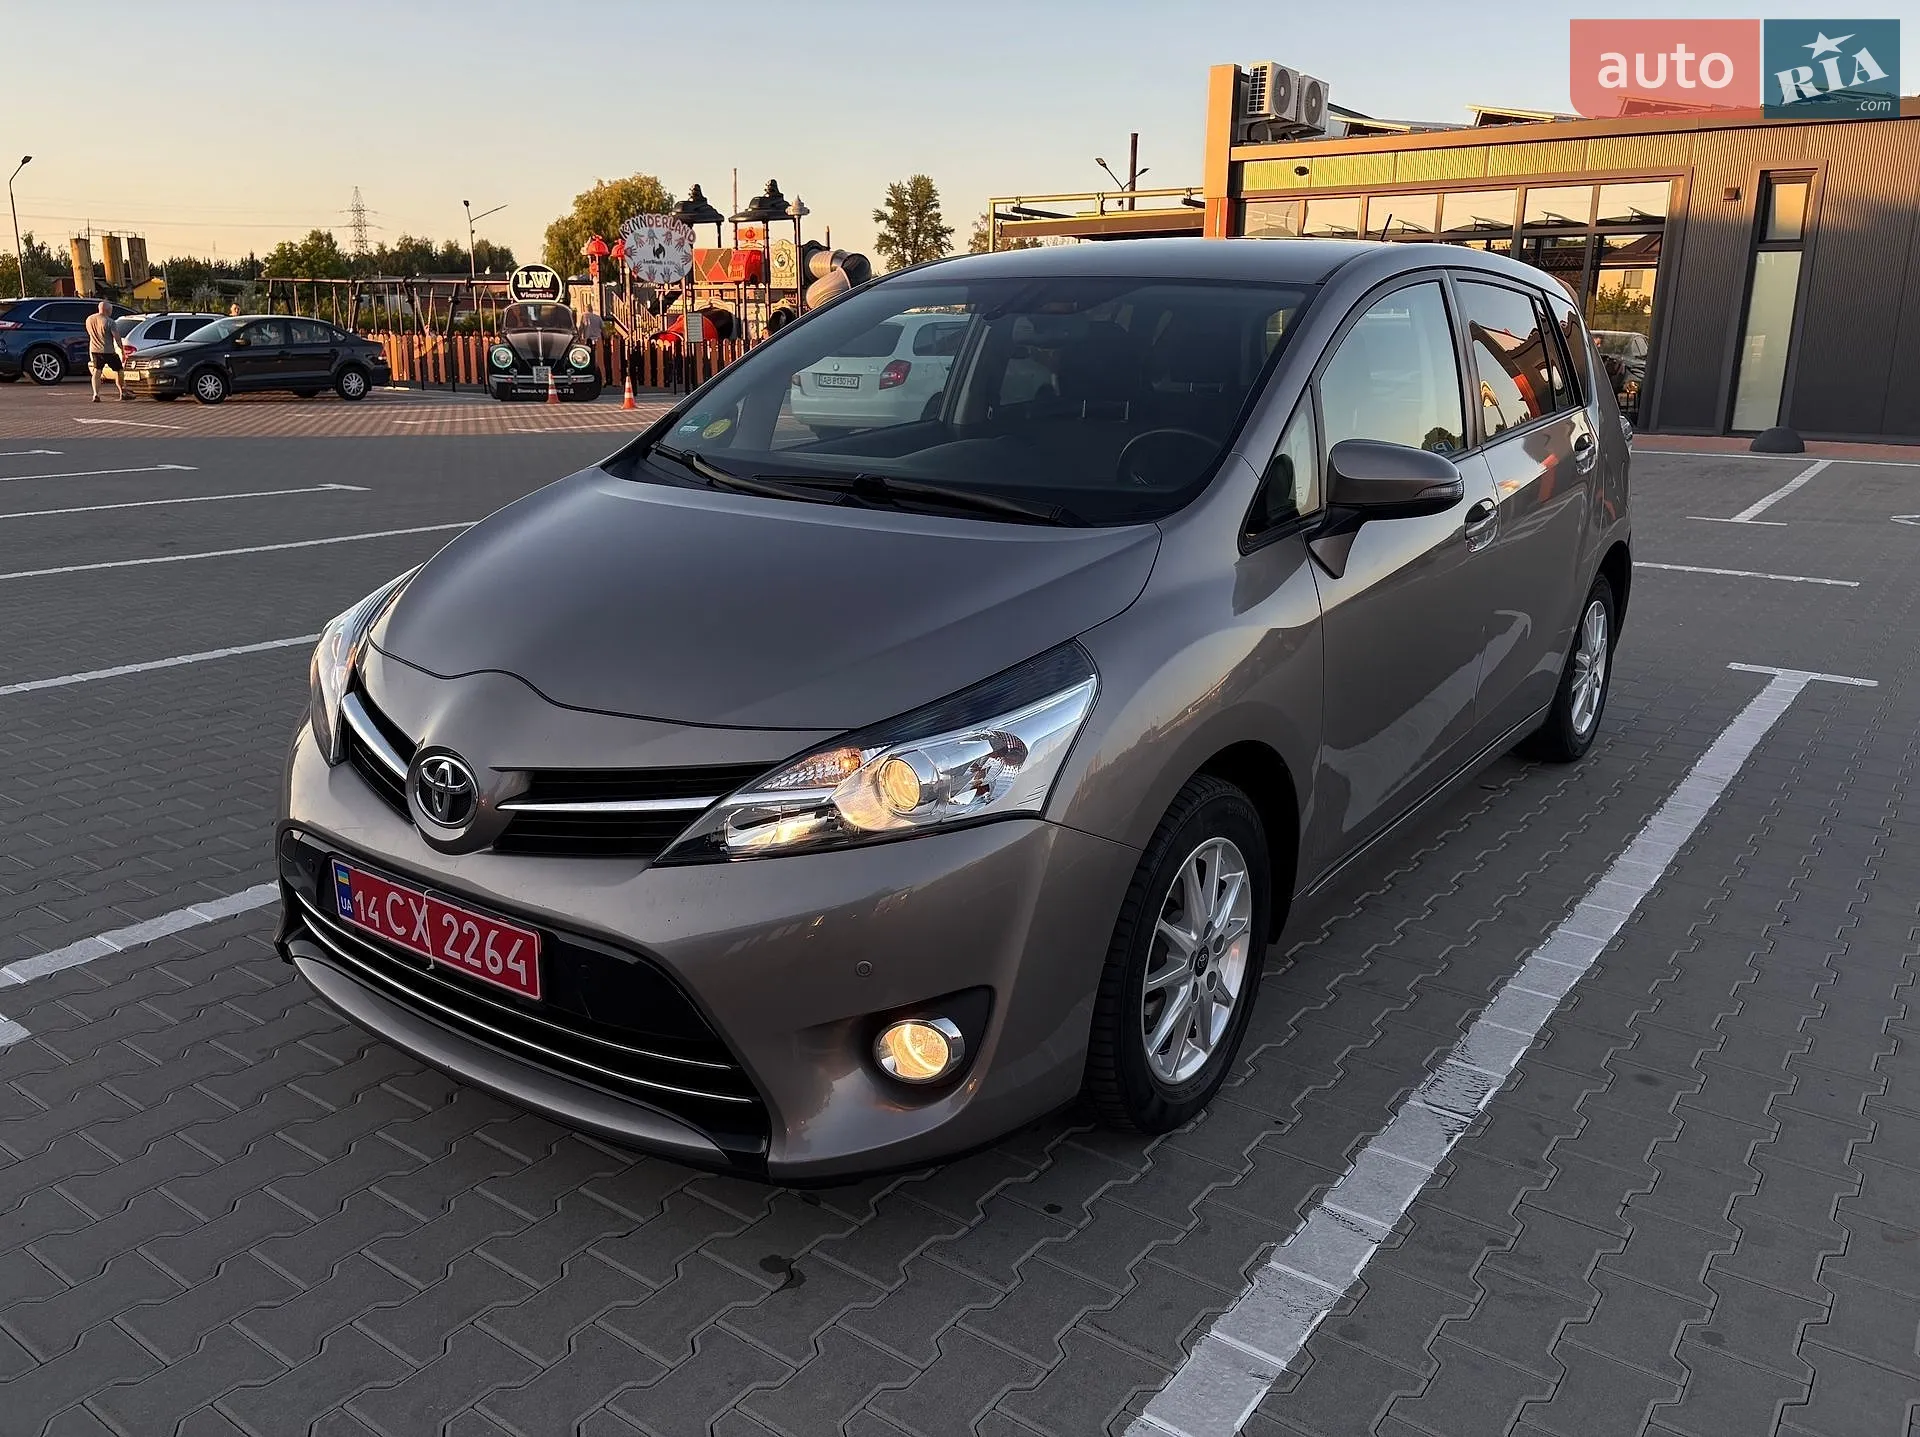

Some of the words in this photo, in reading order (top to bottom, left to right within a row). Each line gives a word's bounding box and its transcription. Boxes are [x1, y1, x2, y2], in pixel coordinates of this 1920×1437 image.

[620, 214, 696, 243] KINNDERLAND
[517, 272, 553, 288] LW
[341, 896, 352, 913] UA
[443, 913, 527, 985] 2264
